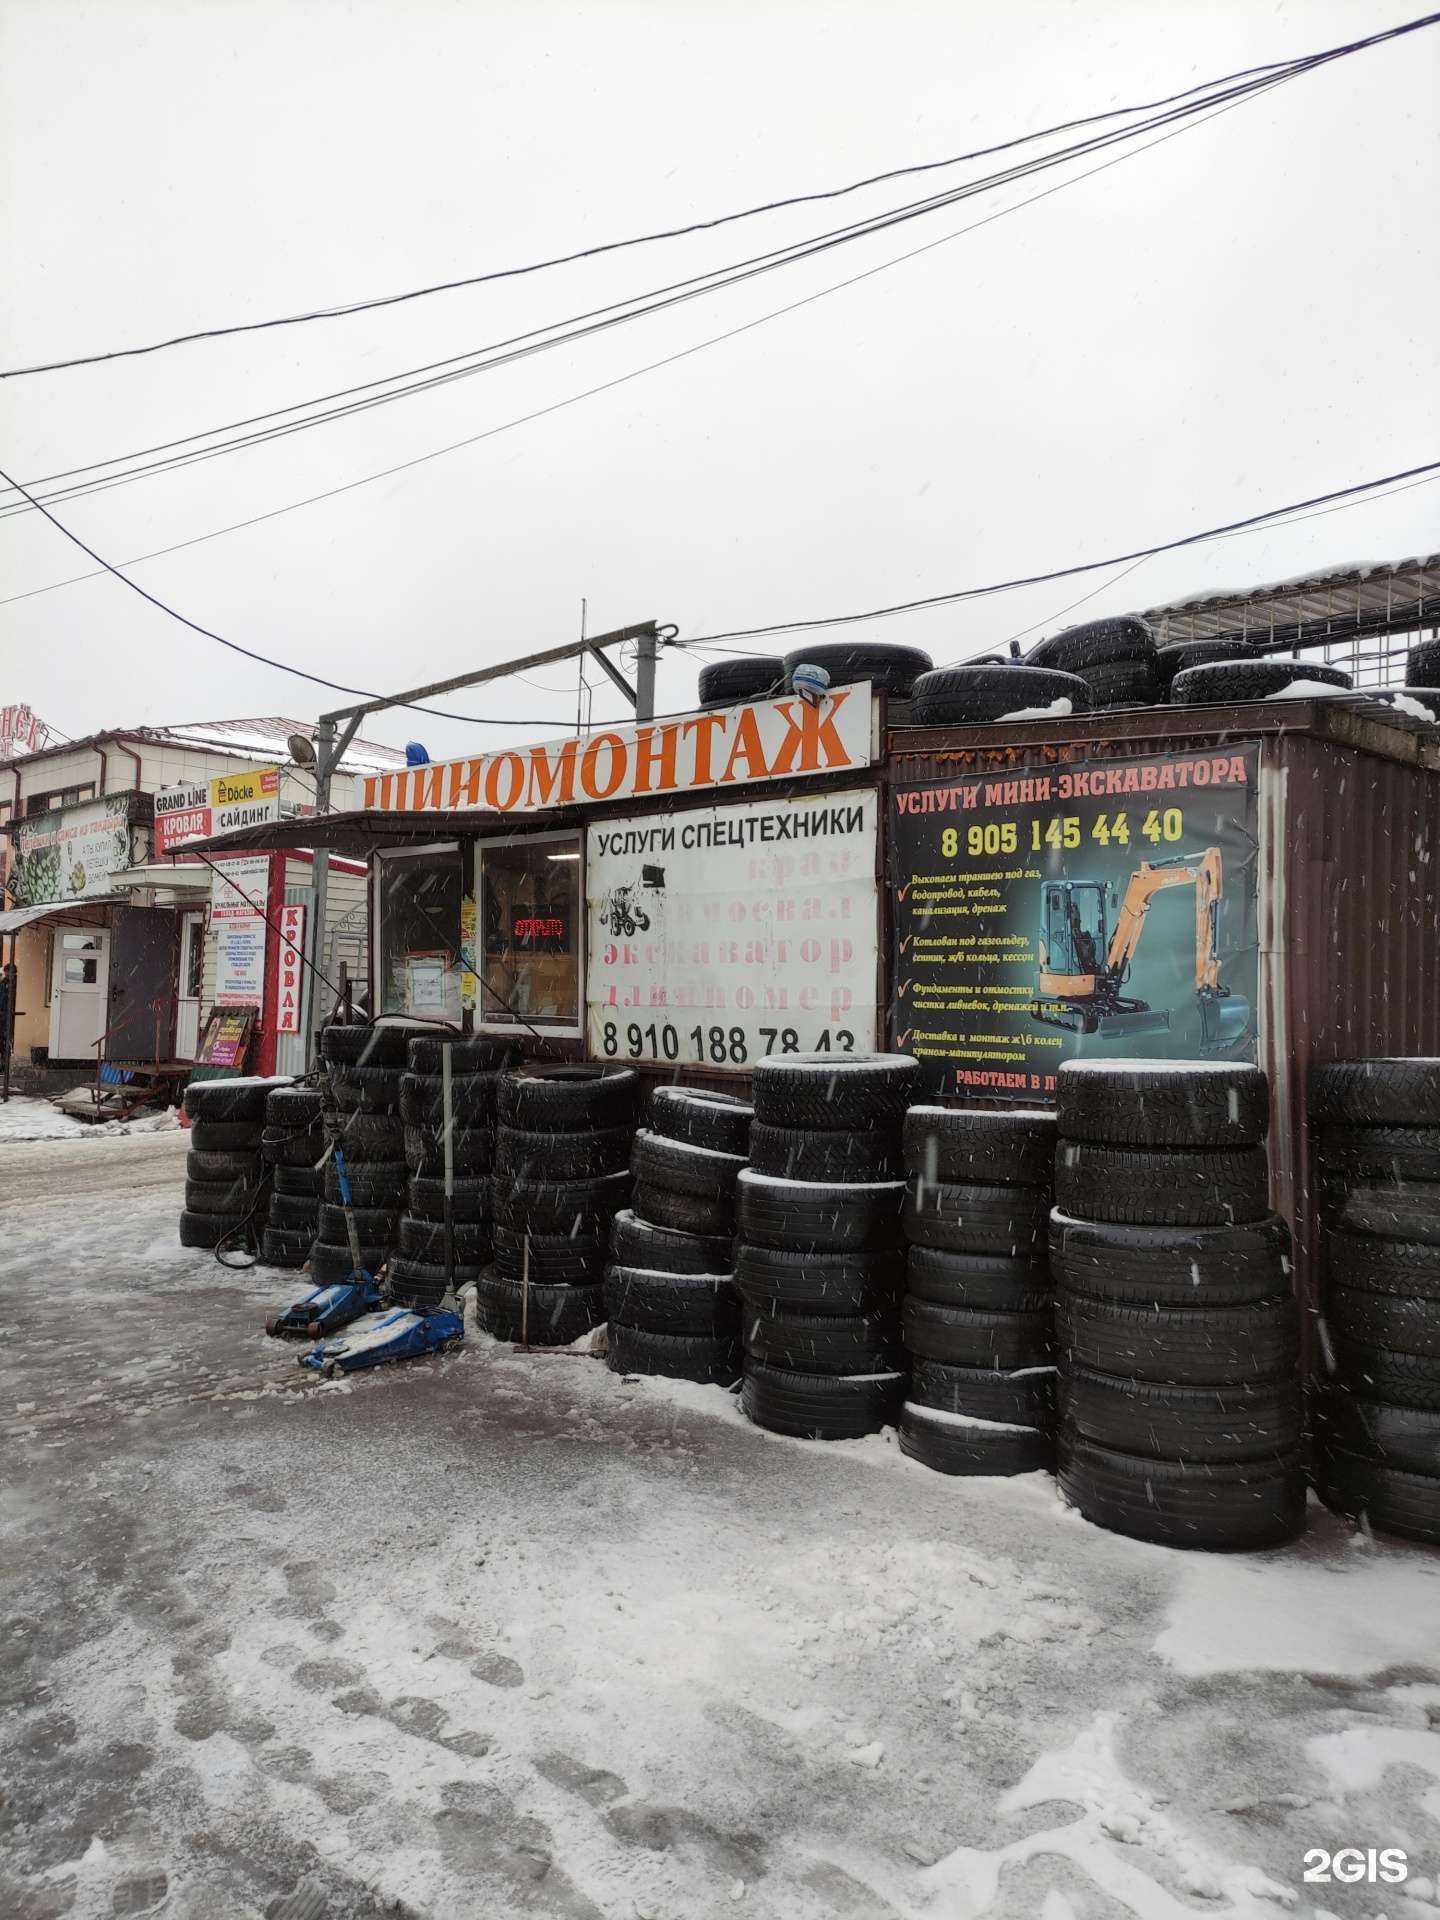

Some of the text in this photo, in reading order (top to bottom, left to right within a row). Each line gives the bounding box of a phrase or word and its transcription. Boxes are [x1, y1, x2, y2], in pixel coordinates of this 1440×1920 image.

[364, 691, 852, 811] ШИНОМОНТАЖ
[227, 785, 254, 801] Döcke
[896, 756, 1248, 815] УСЛУГИ МИНИ-ЭКСКАВАТОРА
[156, 794, 186, 812] GRAND
[163, 812, 204, 836] КРОВЛЯ
[220, 806, 270, 828] САЙДИНГ
[598, 806, 865, 857] УСЛУГИ СПЕЦТЕХНИКИ
[941, 807, 1184, 857] 8 905 145 44 40
[912, 868, 1042, 885] Выкопаем траншею под газ,
[911, 886, 1001, 901] водопровод, кабель,
[971, 902, 1008, 916] дренаж
[913, 935, 958, 947] Котлован
[959, 935, 976, 947] под
[603, 937, 853, 973] эксаватор
[912, 951, 1034, 964] септик, ж/б кольца, кессон
[282, 909, 299, 1028] КРОВЛЯ
[912, 983, 973, 995] Фундаменты
[974, 985, 982, 994] и
[912, 1001, 945, 1010] чистка
[946, 1000, 990, 1012] ливневок,
[992, 1000, 1037, 1012] дренажей
[603, 1021, 618, 1057] 8
[627, 1023, 679, 1060] 910
[690, 1025, 748, 1064] 188
[759, 1027, 800, 1056] 78
[912, 1029, 958, 1041] Доставка
[969, 1035, 1011, 1045] монтаж
[1012, 1033, 1032, 1045] ж\б
[1034, 1037, 1063, 1048] колец
[912, 1047, 1027, 1063] краном-манипулятором
[956, 1069, 1027, 1089] РАБОТАЕМ
[1030, 1074, 1041, 1089] В
